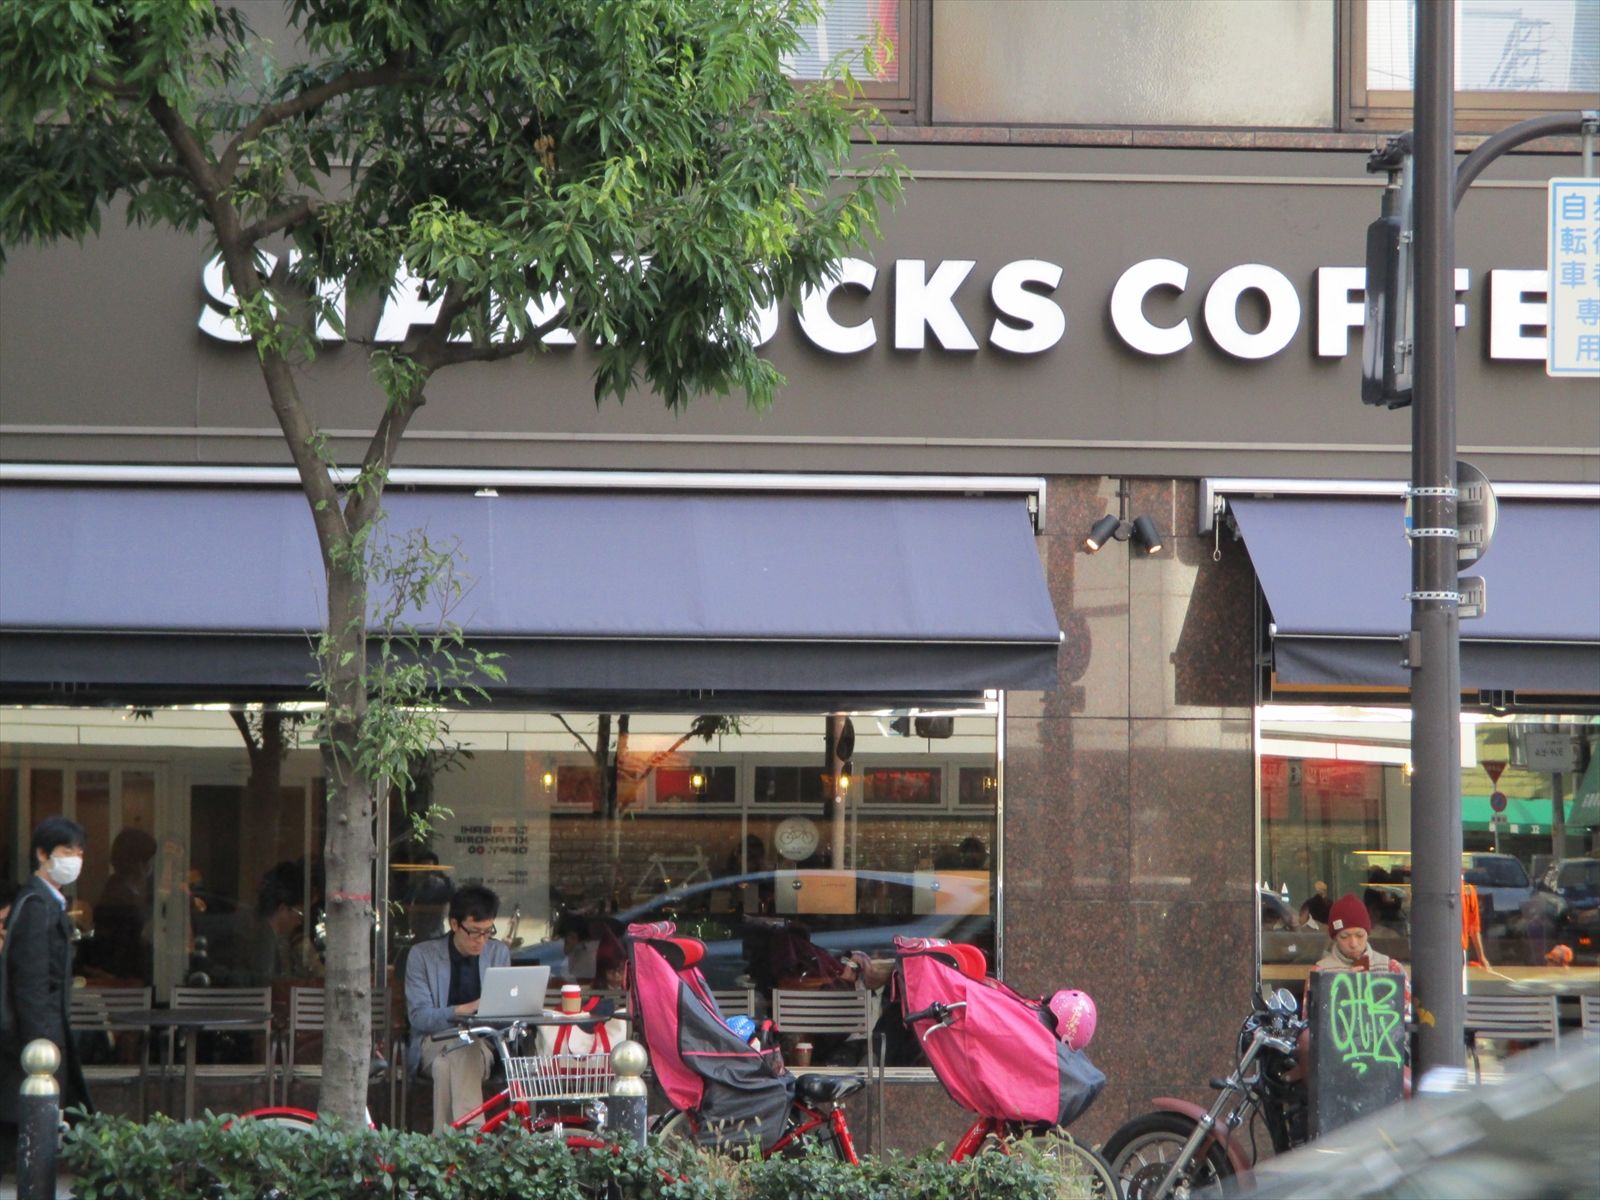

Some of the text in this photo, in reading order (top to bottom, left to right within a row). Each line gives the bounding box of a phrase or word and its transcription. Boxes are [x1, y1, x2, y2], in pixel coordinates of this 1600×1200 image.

[1560, 193, 1587, 289] 自転車
[198, 248, 1548, 360] SACKS COFE
